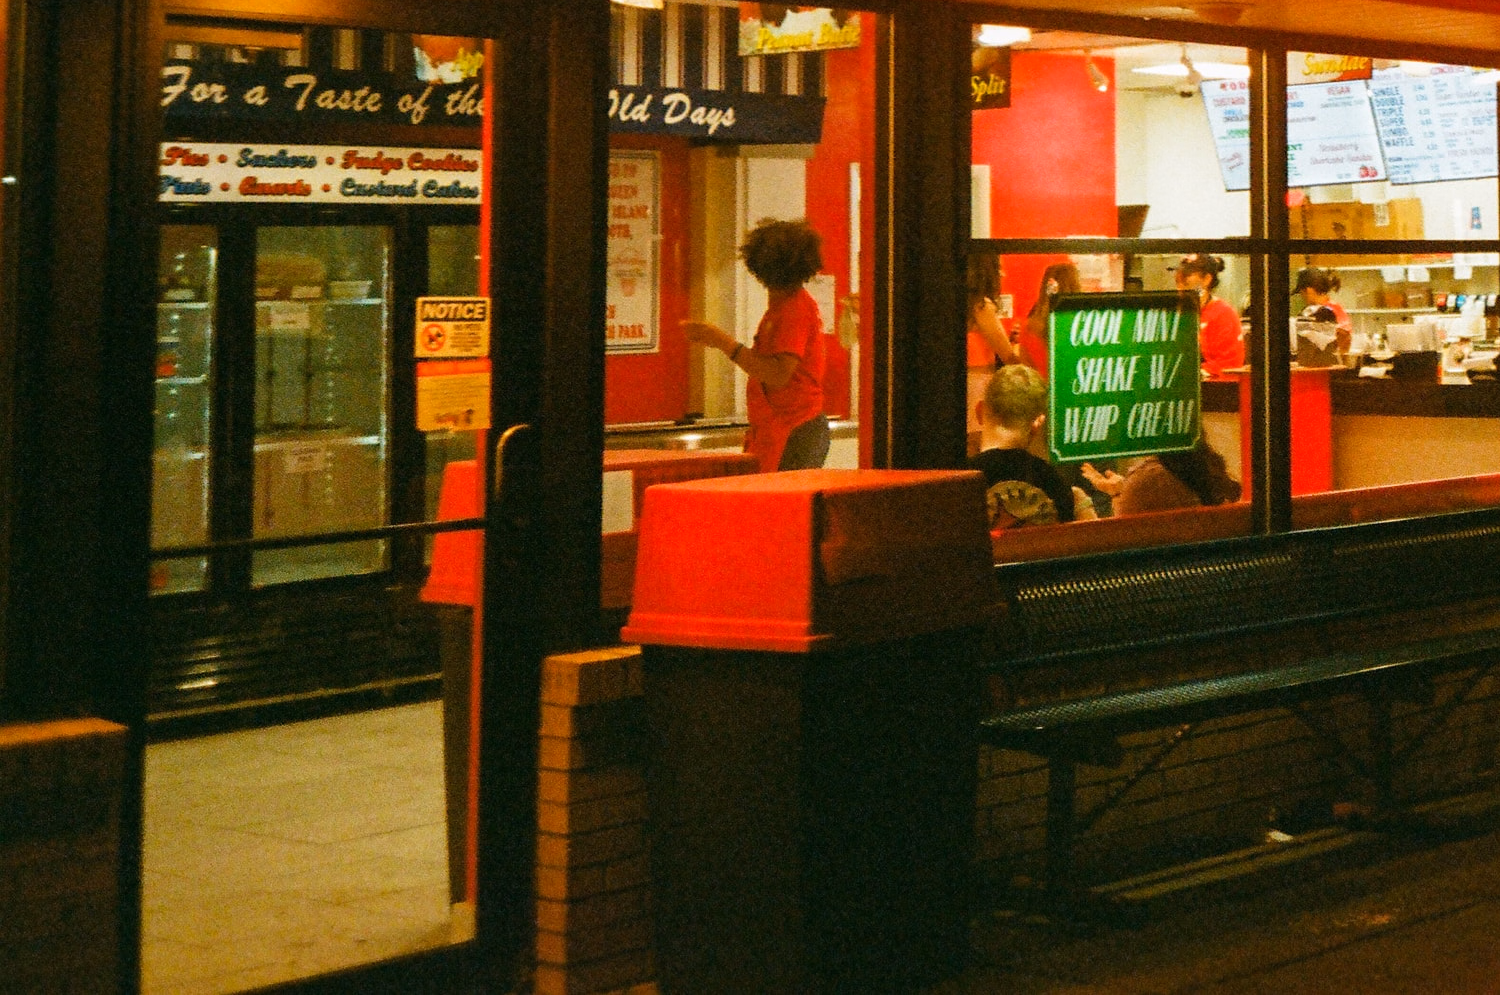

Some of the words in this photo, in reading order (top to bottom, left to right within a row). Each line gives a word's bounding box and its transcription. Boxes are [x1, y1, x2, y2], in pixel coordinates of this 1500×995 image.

[1301, 52, 1369, 76] Sundae
[160, 65, 229, 107] For
[244, 84, 270, 106] a
[284, 73, 383, 112] Taste
[398, 85, 434, 125] of
[661, 92, 737, 135] Days
[971, 73, 1006, 103] Split
[406, 151, 480, 173] Cookies
[340, 177, 418, 197] Custard
[421, 178, 480, 199] Cakes
[423, 303, 486, 319] NOTICE
[1070, 309, 1123, 347] COOL
[1132, 309, 1182, 344] MINT
[1071, 355, 1141, 396] SHAKE
[1063, 404, 1120, 445] WHIP
[1126, 399, 1196, 439] CREAM
